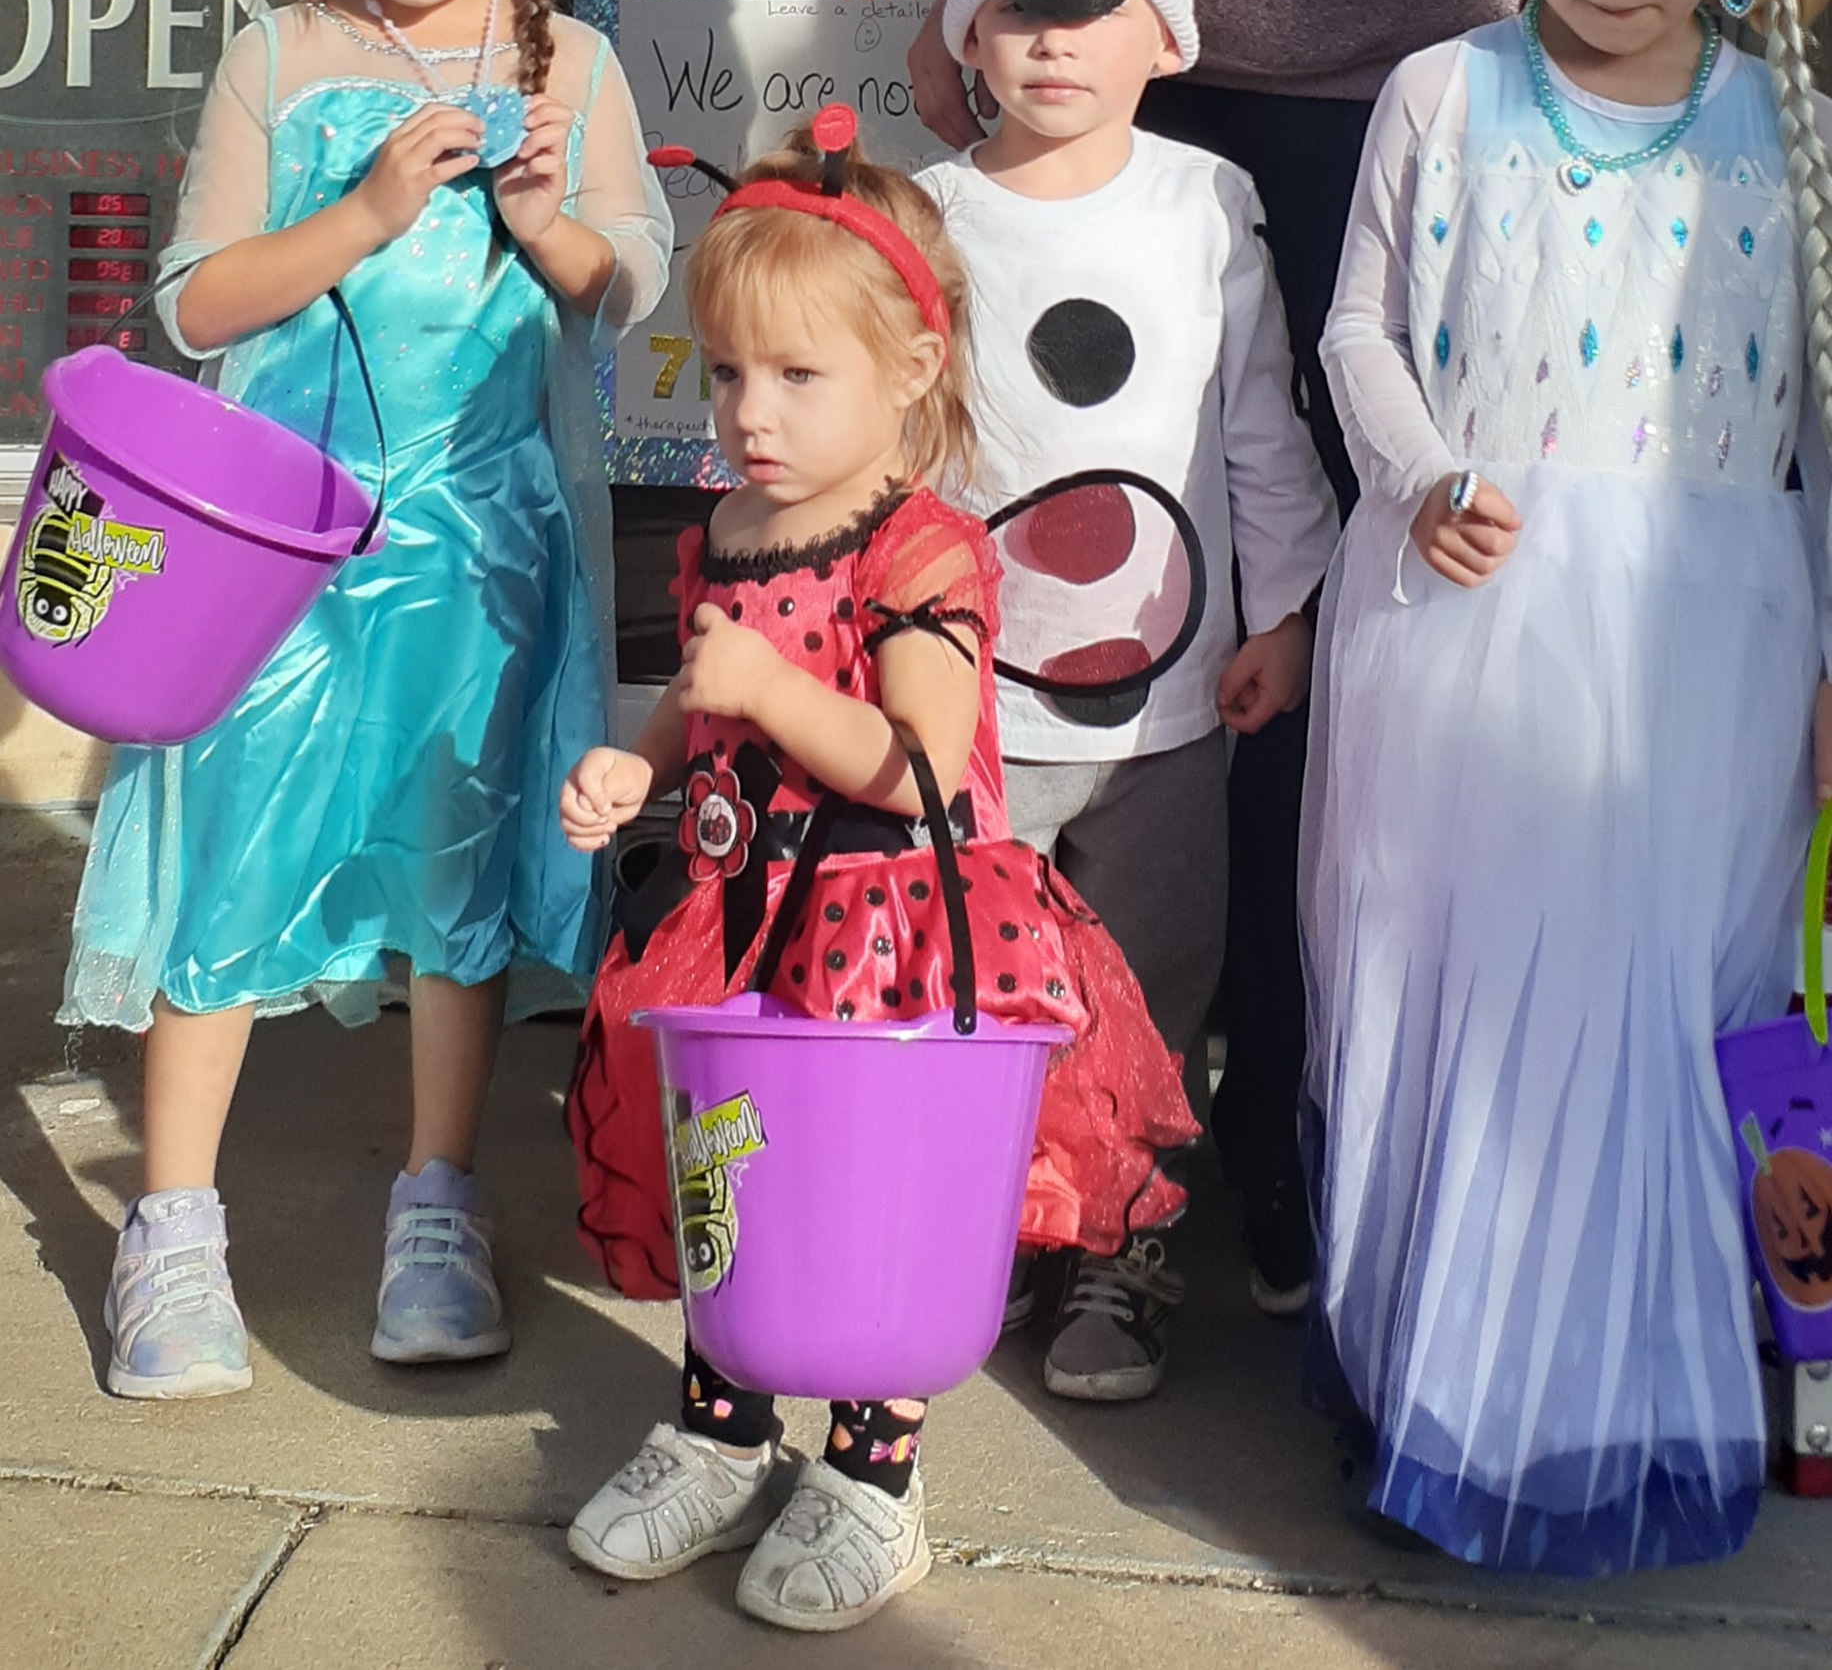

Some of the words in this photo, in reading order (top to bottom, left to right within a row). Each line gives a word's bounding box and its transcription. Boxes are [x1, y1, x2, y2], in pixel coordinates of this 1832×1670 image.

[767, 1, 819, 16] Leave
[834, 6, 848, 17] a
[652, 27, 743, 113] We
[763, 72, 834, 112] are
[0, 148, 141, 180] USINESS
[48, 464, 89, 512] HAPPY
[66, 518, 168, 571] Halloween
[685, 1098, 764, 1171] alloween
